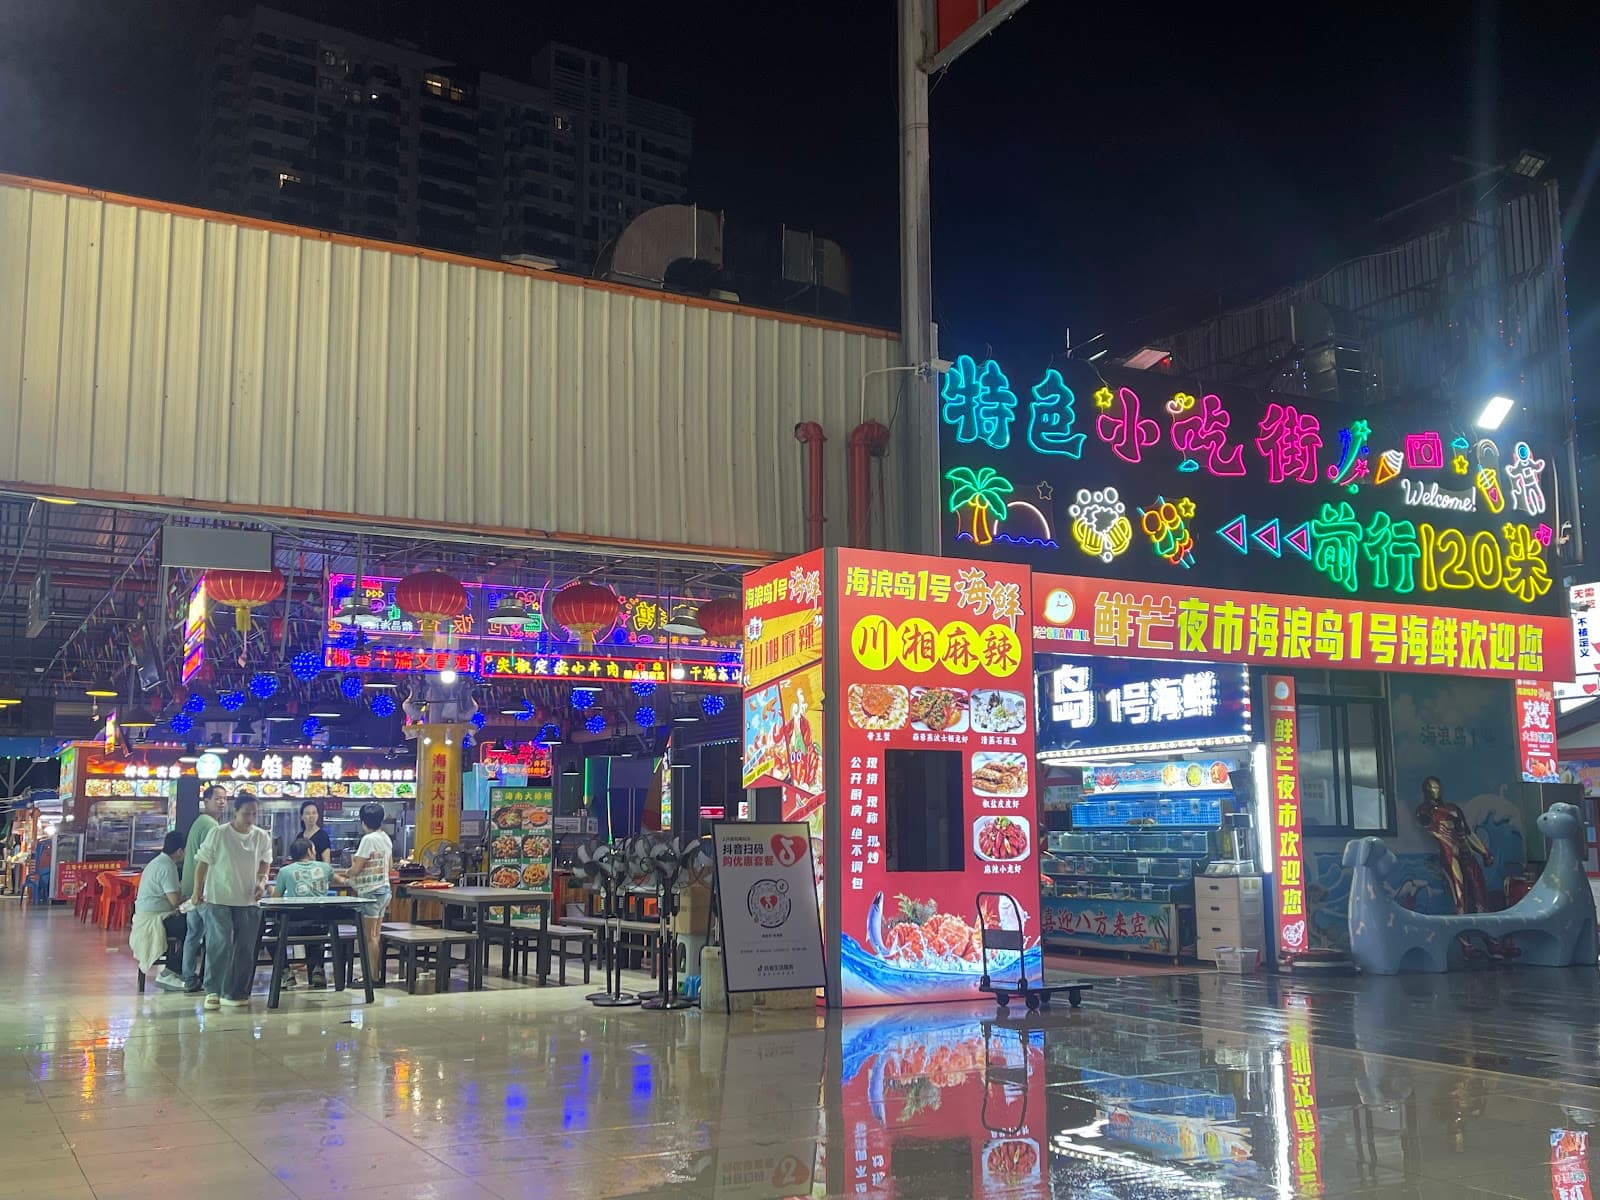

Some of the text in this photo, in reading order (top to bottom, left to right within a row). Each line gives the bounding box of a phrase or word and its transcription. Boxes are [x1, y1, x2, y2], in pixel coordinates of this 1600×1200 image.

[941, 354, 1323, 484] 特色小吃街
[1401, 478, 1477, 513] Welcome!
[1311, 501, 1553, 603] 前行120米
[844, 566, 1024, 632] 海浪岛1号海鲜
[1093, 591, 1544, 673] 鲜芒夜市海浪岛1号海鲜欢迎您
[857, 619, 1018, 673] 川湘麻辣
[1274, 718, 1303, 916] 鲜芒夜市欢迎您
[1040, 906, 1148, 938] 喜迎八方来宾
